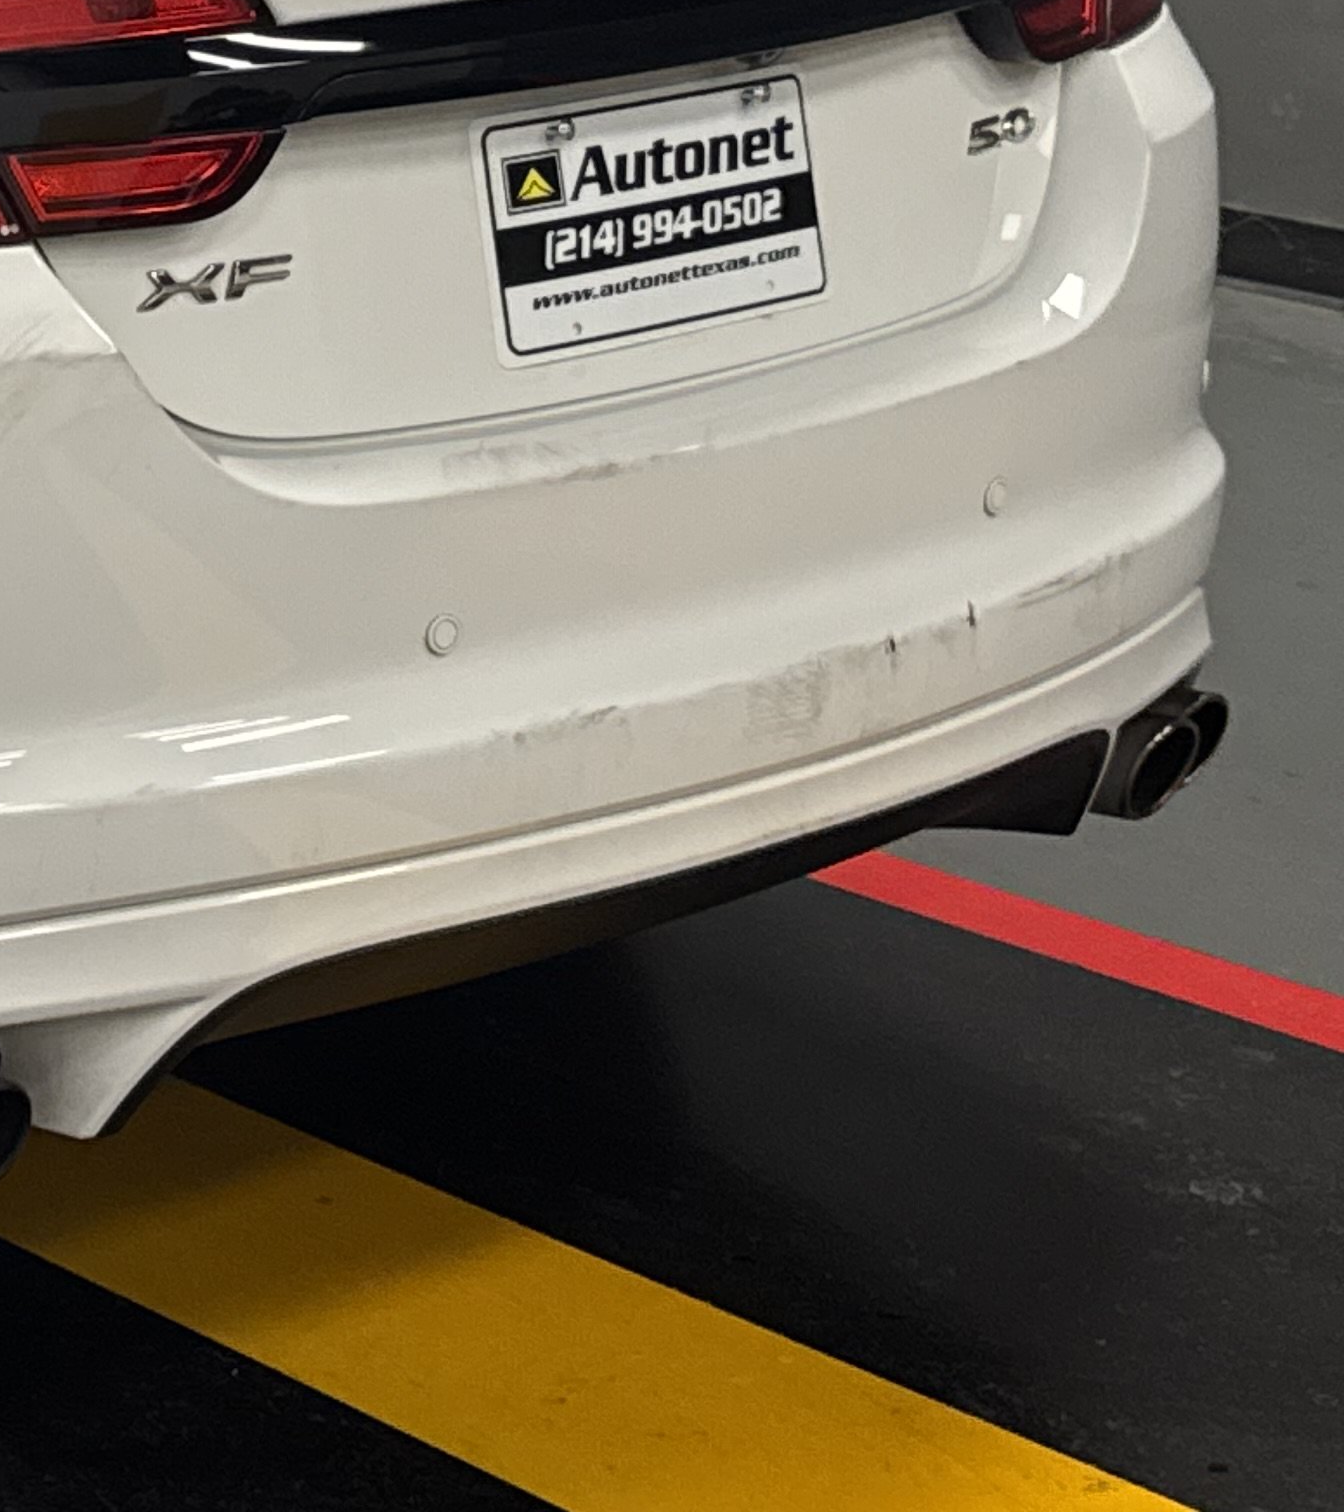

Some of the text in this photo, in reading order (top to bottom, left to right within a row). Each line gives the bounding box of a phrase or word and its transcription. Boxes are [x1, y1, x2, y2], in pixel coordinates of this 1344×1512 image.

[571, 116, 795, 201] Autonet
[545, 187, 783, 271] (214) 994-0502
[136, 254, 293, 313] XF
[533, 244, 800, 311] www.autonettexas.com
